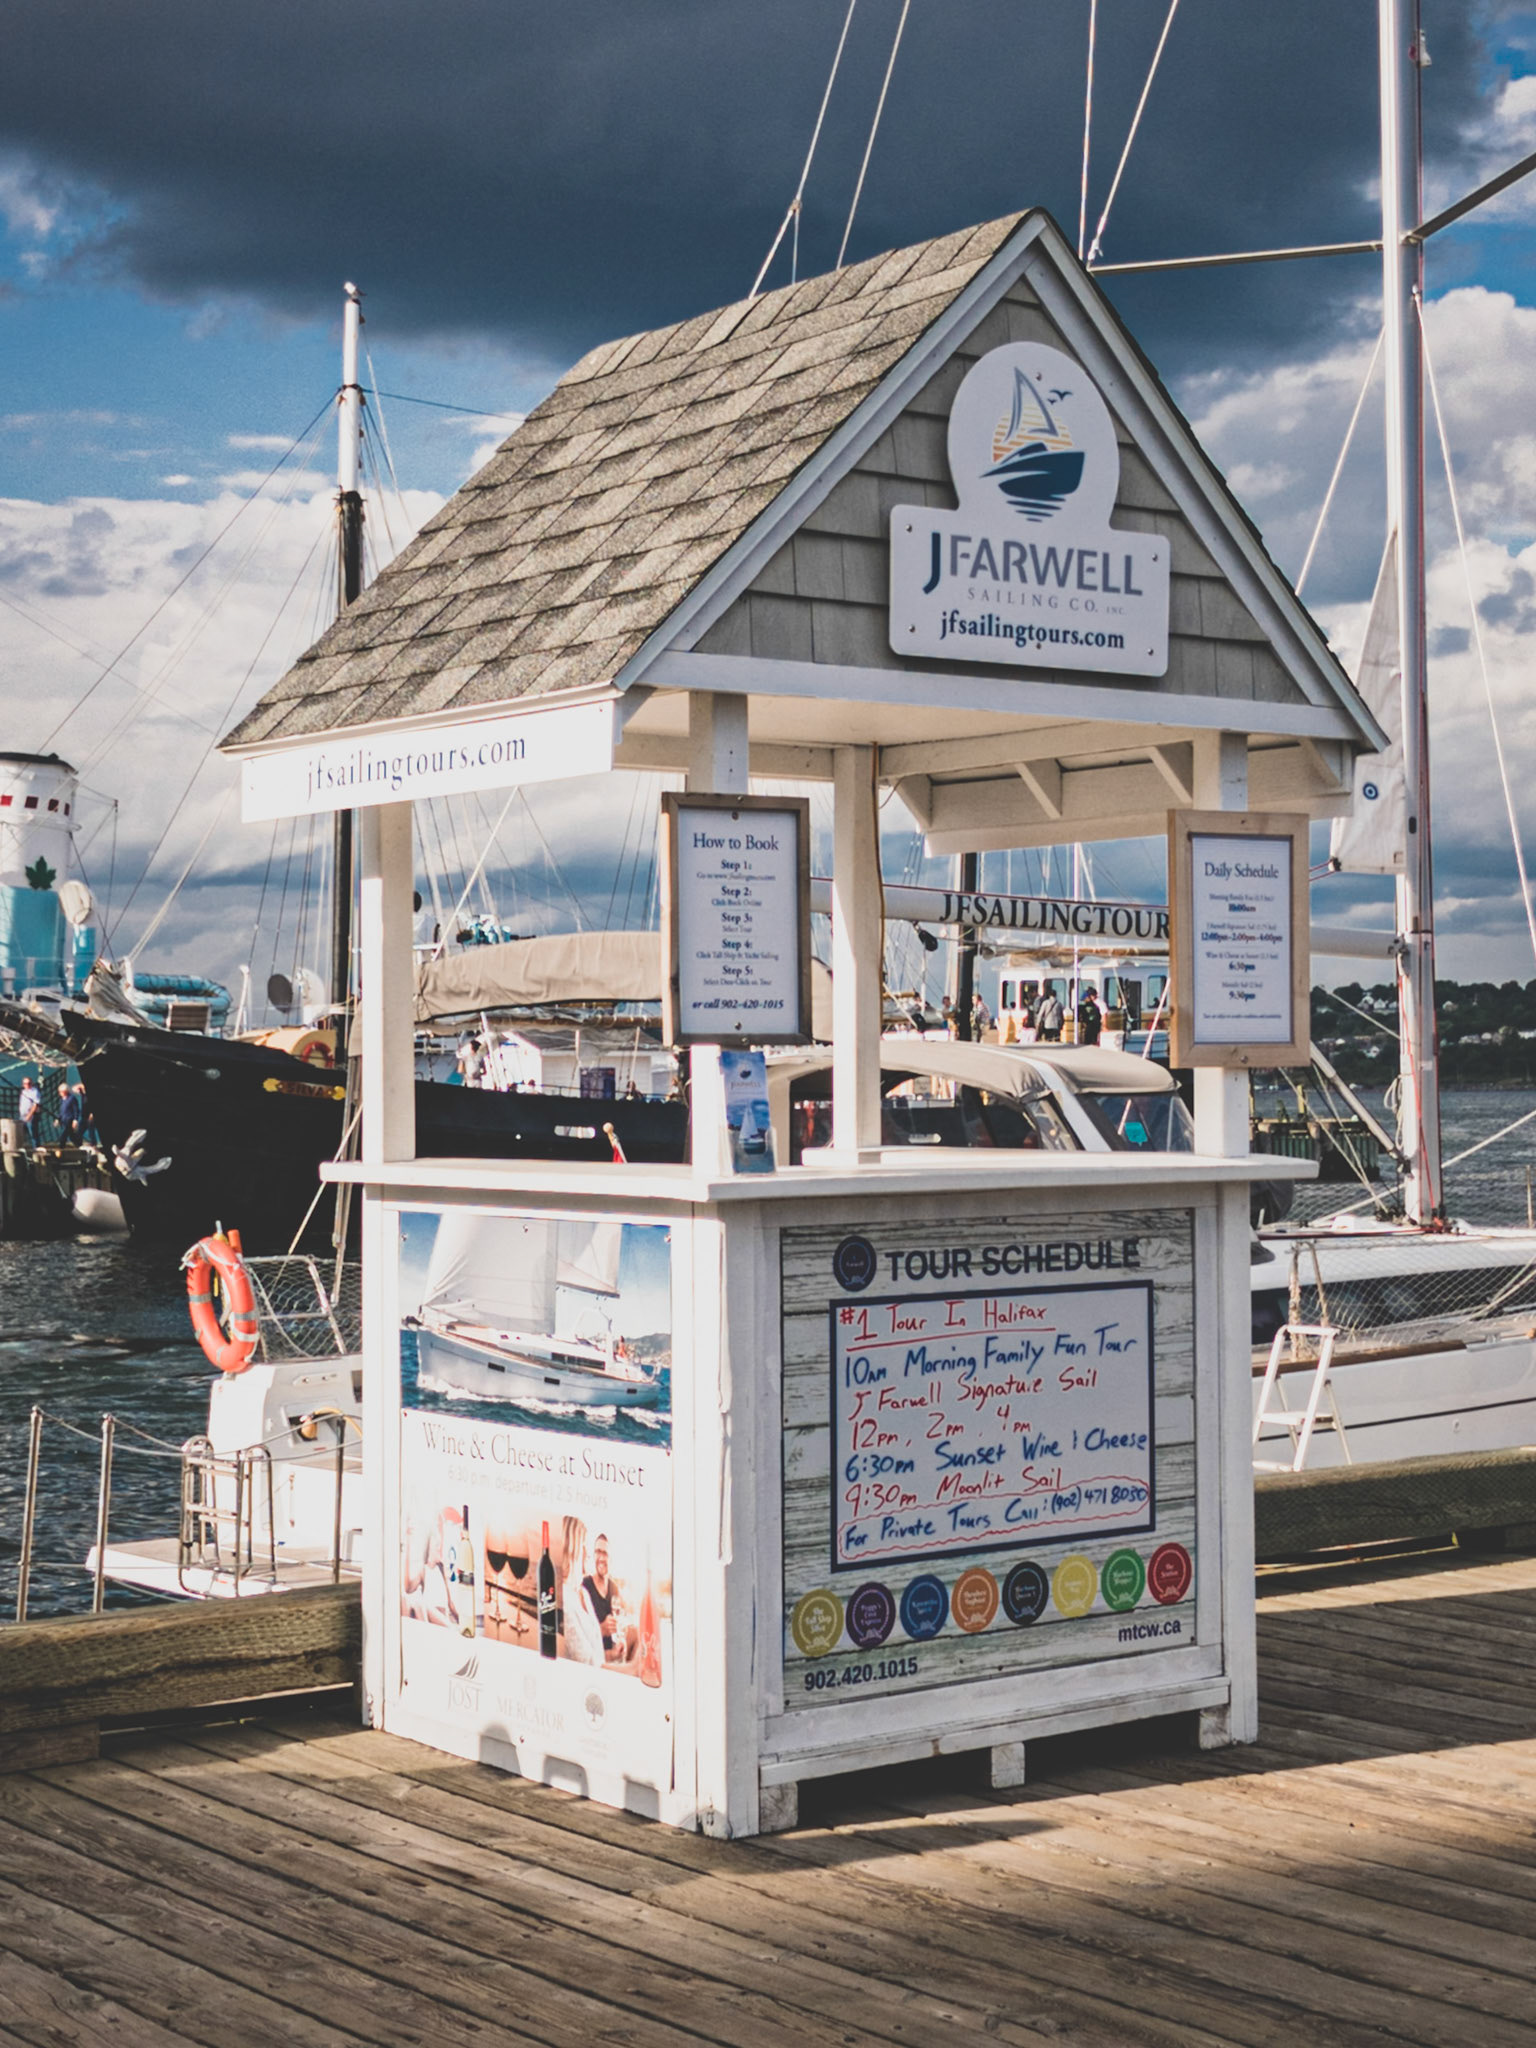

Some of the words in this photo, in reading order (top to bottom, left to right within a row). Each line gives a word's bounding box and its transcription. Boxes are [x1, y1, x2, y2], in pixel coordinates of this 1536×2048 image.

[967, 586, 1059, 609] SAILING
[1069, 598, 1099, 614] CO.
[939, 610, 1125, 649] jfsailingtours.com
[307, 736, 527, 801] jfsailingtours.com
[692, 832, 725, 849] How
[728, 837, 742, 850] to
[745, 834, 780, 851] Book
[720, 859, 741, 872] Step
[743, 860, 753, 871] 1:
[1204, 862, 1233, 882] Daily
[1234, 862, 1280, 880] Schedule
[720, 884, 741, 899] Step
[743, 886, 753, 898] 2:
[721, 911, 742, 925] Step
[743, 912, 753, 923] 3:
[721, 938, 742, 952] Step
[744, 938, 754, 950] 4:
[721, 964, 743, 979] Step
[744, 964, 754, 977] 5:
[1228, 961, 1256, 973] 6:30pm
[692, 1000, 702, 1010] or
[703, 998, 721, 1010] call
[721, 999, 785, 1010] 902-420-1015
[1228, 990, 1256, 1003] 9:30pm
[885, 1247, 973, 1282] TOUR
[981, 1238, 1141, 1276] SCHEDULE
[839, 1307, 878, 1341] #1
[886, 1303, 928, 1334] Tour
[944, 1300, 966, 1327] In
[983, 1299, 1048, 1329] Halifax
[903, 1345, 977, 1381] Morning
[983, 1335, 1045, 1375] Family
[1053, 1333, 1087, 1356] Fun
[1093, 1322, 1138, 1357] Tour
[878, 1380, 941, 1412] Farwell
[1058, 1366, 1098, 1392] Sail
[422, 1421, 465, 1458] Wine
[469, 1431, 485, 1460] &
[491, 1433, 553, 1473] Cheese
[558, 1455, 575, 1477] at
[581, 1447, 645, 1488] Sunset
[934, 1440, 1007, 1472] Sunset
[1021, 1431, 1063, 1461] Wine
[1084, 1426, 1148, 1451] Cheese
[935, 1469, 1005, 1501] Moonlit
[1021, 1465, 1063, 1493] Sail
[845, 1524, 869, 1551] For
[880, 1516, 937, 1542] Private
[947, 1502, 992, 1532] Tours
[1118, 1618, 1182, 1644] mtcw.ca
[804, 1656, 919, 1692] 902.420.1015
